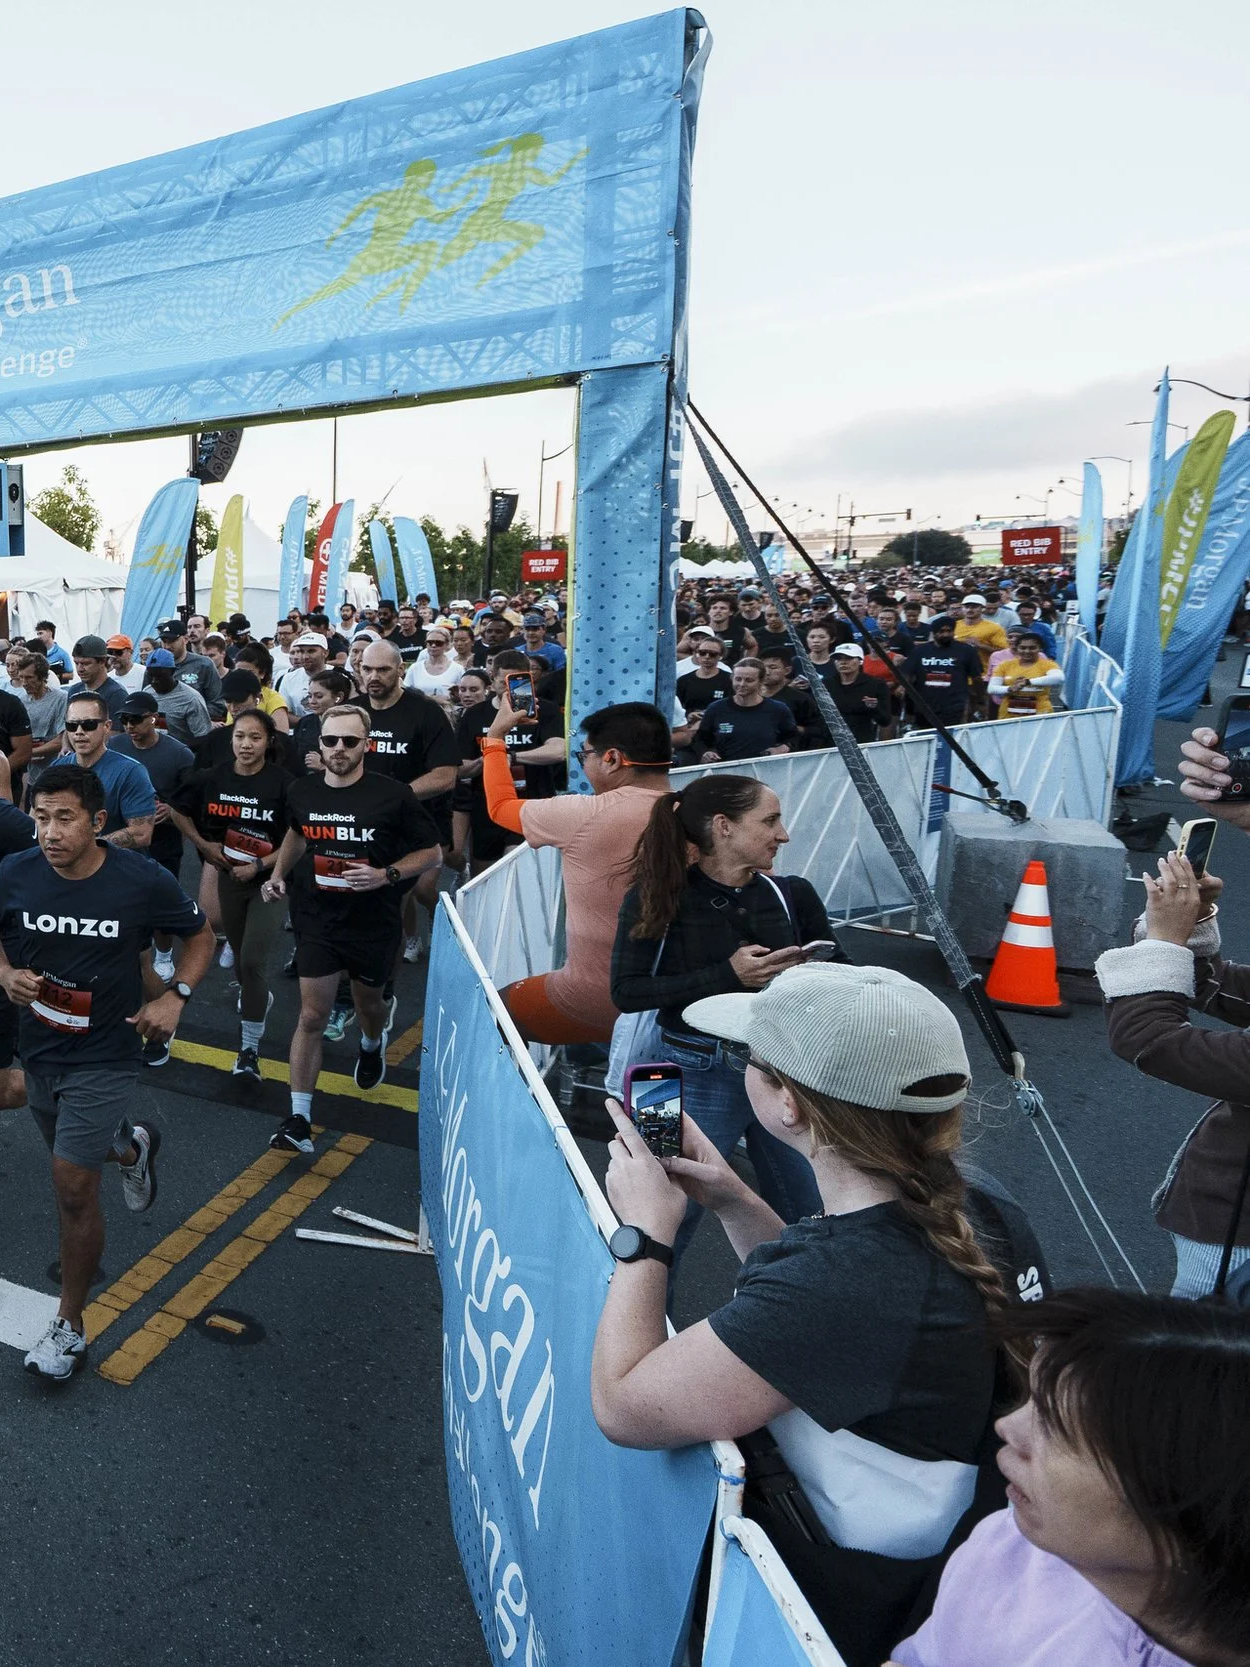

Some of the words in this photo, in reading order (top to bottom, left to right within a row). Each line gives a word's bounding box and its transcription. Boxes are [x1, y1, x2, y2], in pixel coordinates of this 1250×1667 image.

[1010, 539, 1032, 548] RED
[1033, 538, 1052, 546] BIB
[1014, 547, 1049, 556] ENTRY
[545, 558, 559, 566] BIB
[531, 565, 556, 573] ENTRY
[921, 656, 955, 667] trinet
[220, 793, 259, 804] BlackRock
[208, 802, 274, 822] RUNBLK
[309, 813, 356, 823] BlackRock
[302, 825, 376, 842] RUNBLK
[23, 911, 120, 939] Lonza
